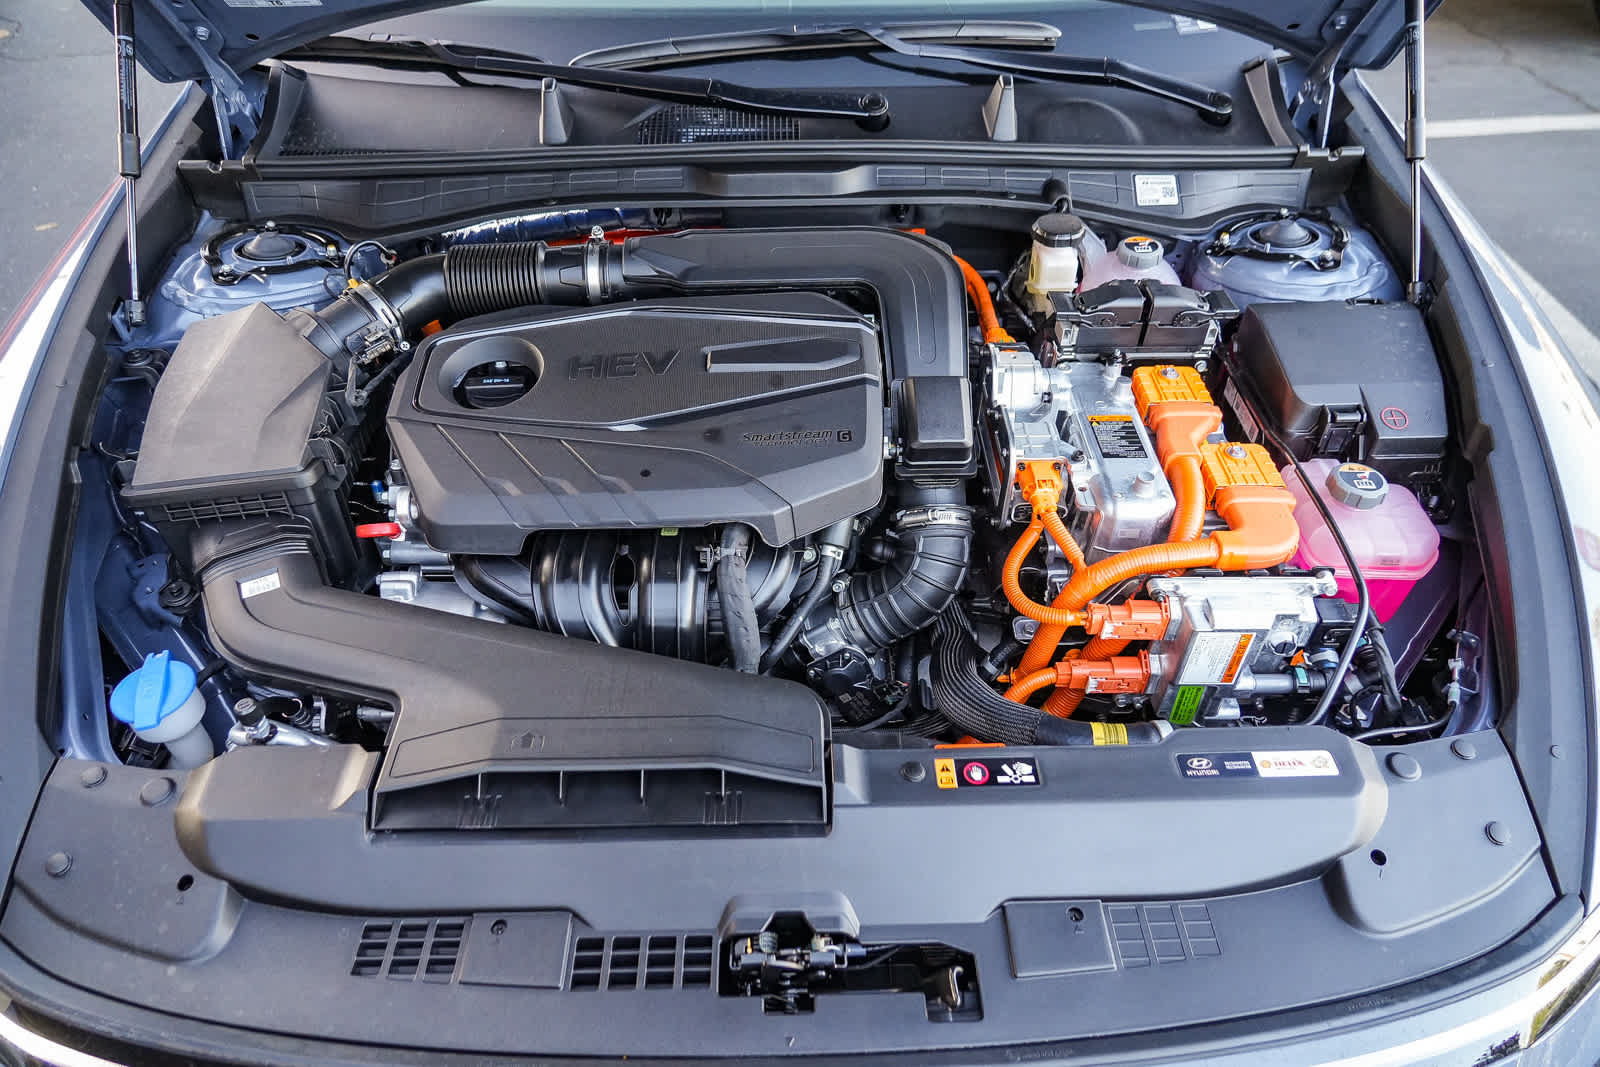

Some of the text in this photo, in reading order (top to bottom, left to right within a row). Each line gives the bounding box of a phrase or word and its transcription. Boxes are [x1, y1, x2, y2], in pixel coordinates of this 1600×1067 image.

[568, 351, 681, 382] HEV
[743, 430, 853, 443] Smartstream G
